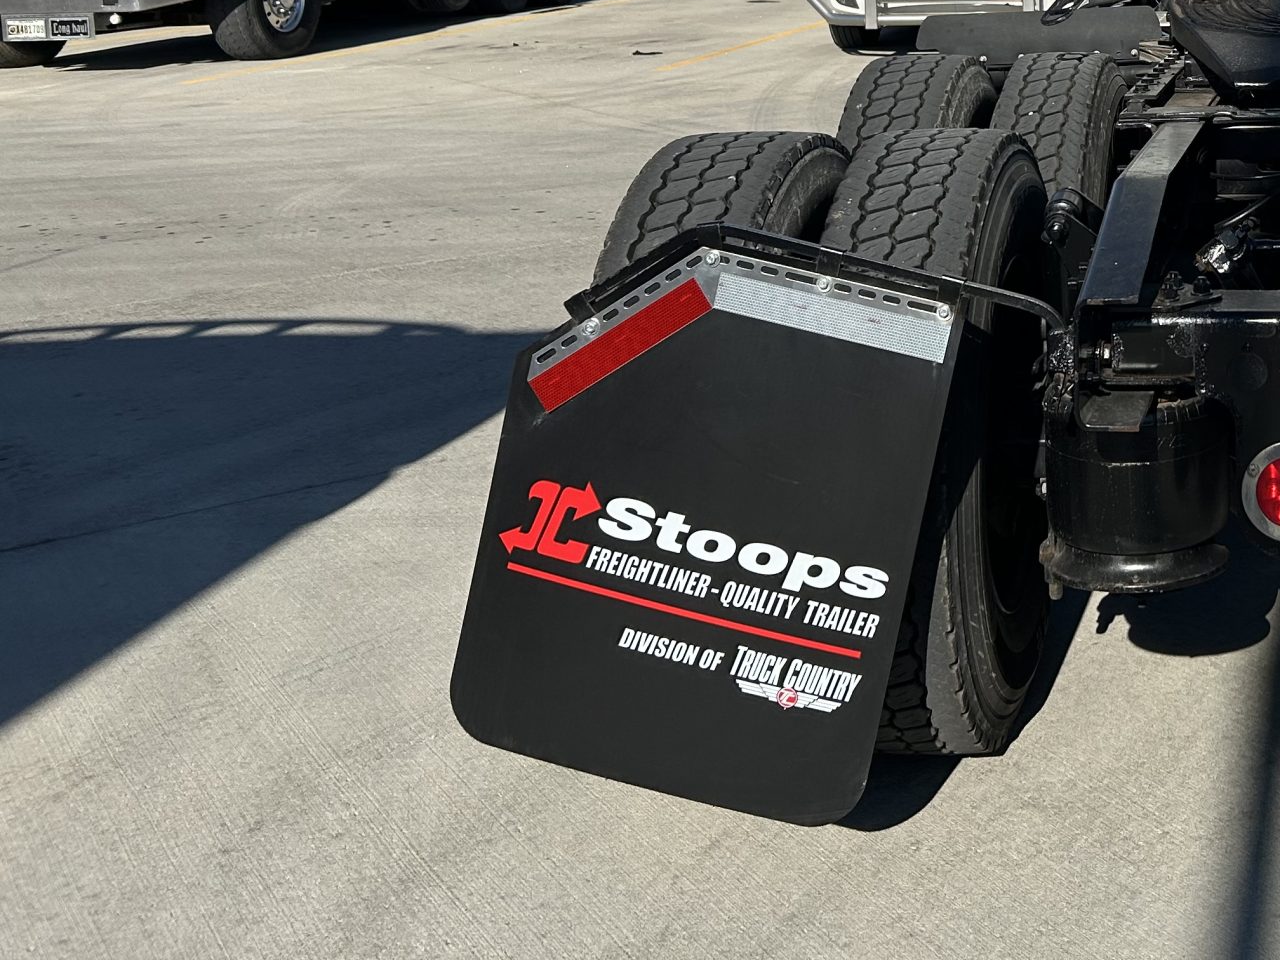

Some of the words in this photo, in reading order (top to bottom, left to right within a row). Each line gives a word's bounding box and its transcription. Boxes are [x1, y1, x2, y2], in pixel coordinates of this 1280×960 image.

[598, 497, 890, 599] Stoops
[803, 600, 880, 638] TRAILER
[618, 628, 700, 665] DIVISION
[699, 649, 725, 671] OF
[730, 645, 788, 686] TRUCK
[783, 658, 863, 703] COUNTRY
